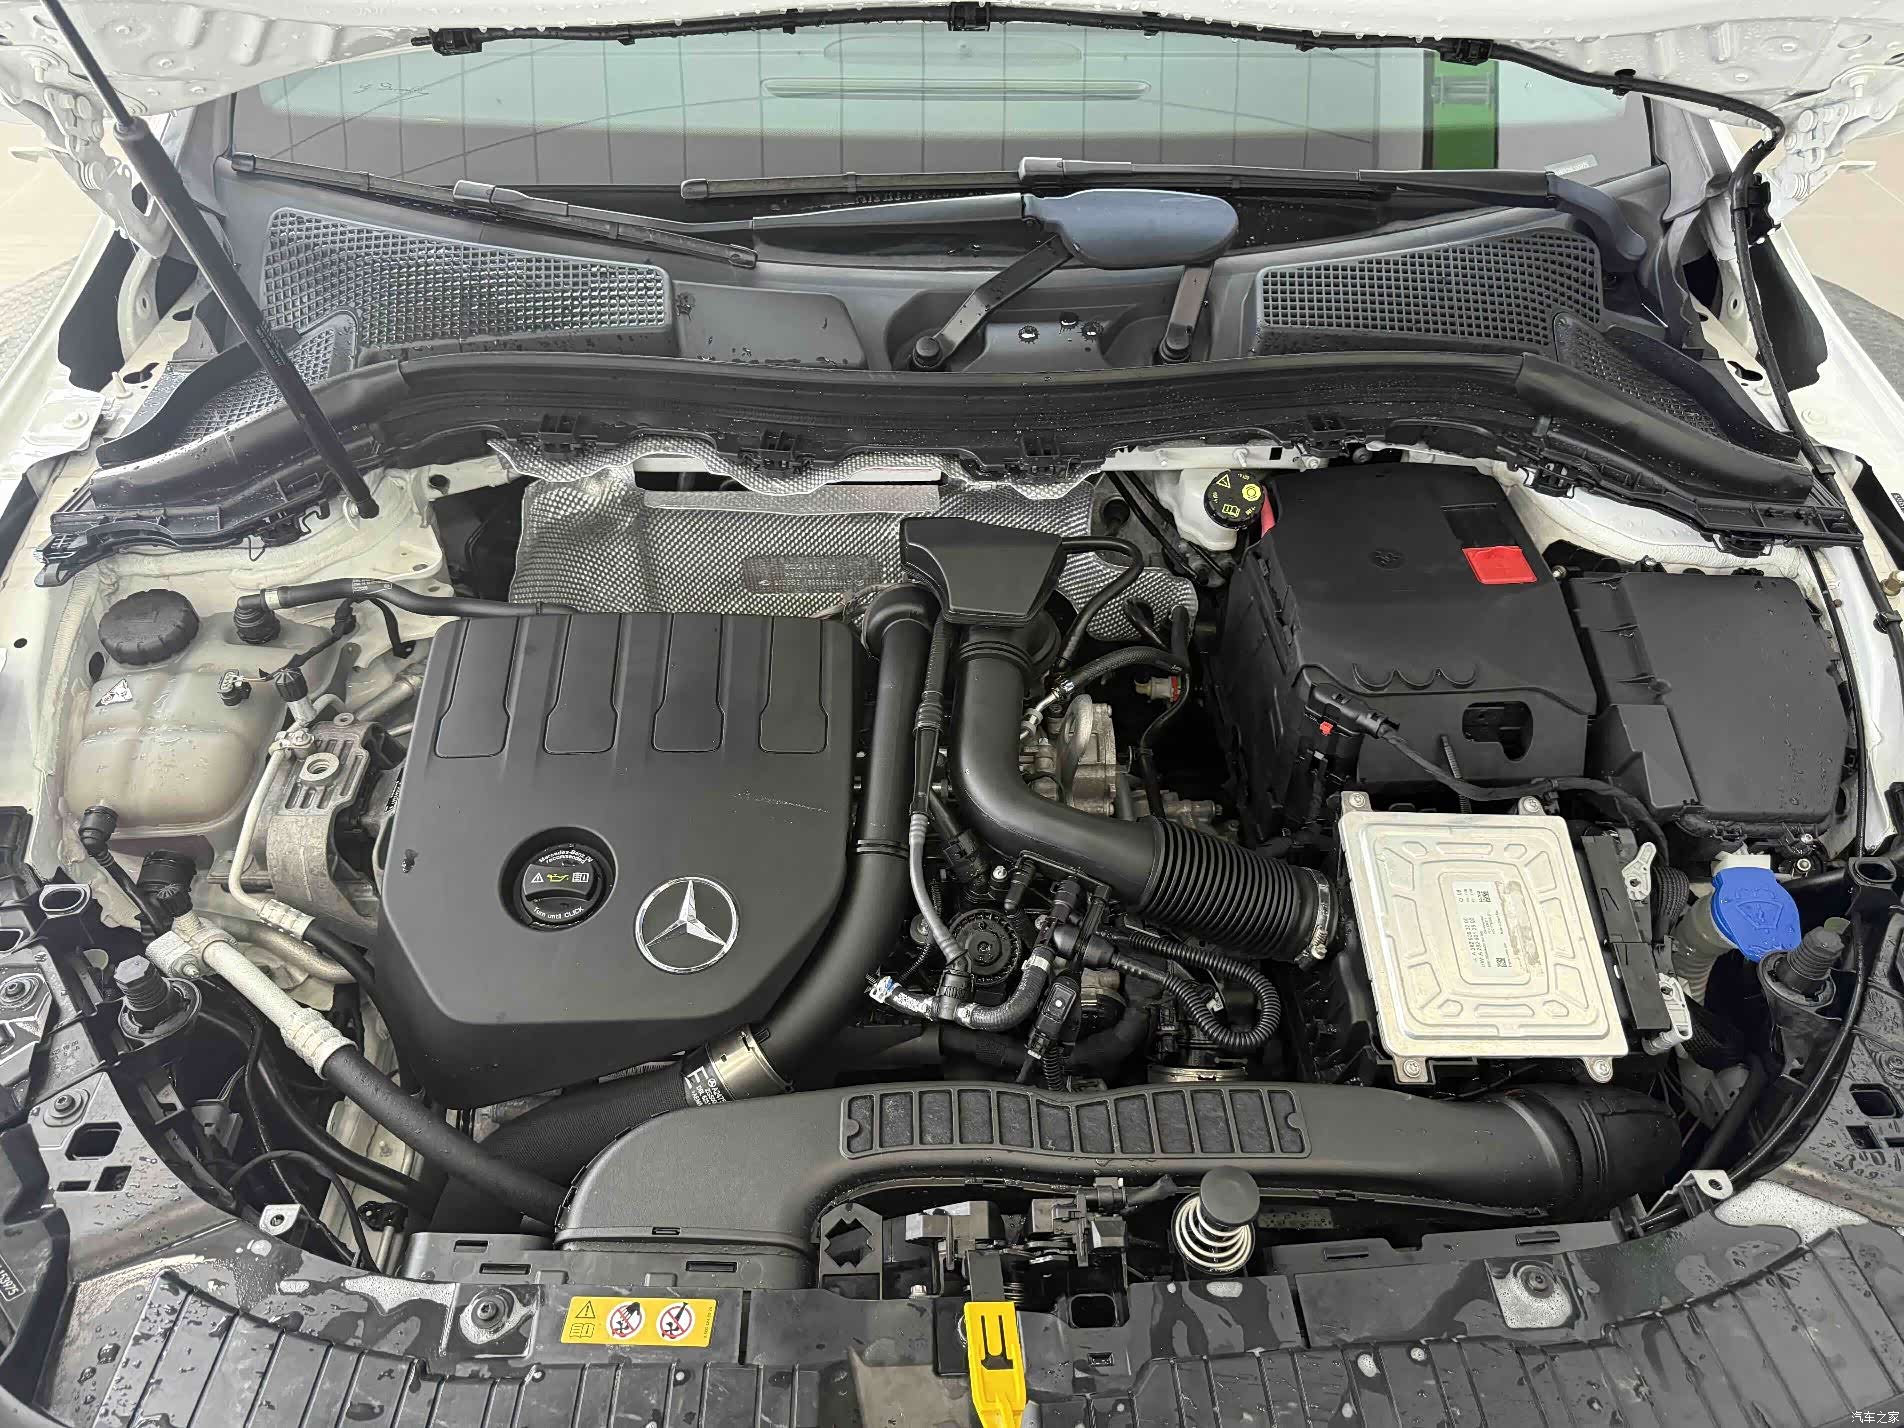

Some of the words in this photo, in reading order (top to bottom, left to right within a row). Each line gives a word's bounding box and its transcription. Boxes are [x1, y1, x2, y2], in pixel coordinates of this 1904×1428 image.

[539, 849, 585, 863] Mercedes-Benz
[546, 854, 586, 864] recommended
[533, 906, 546, 917] Turn
[564, 905, 585, 918] CLICK
